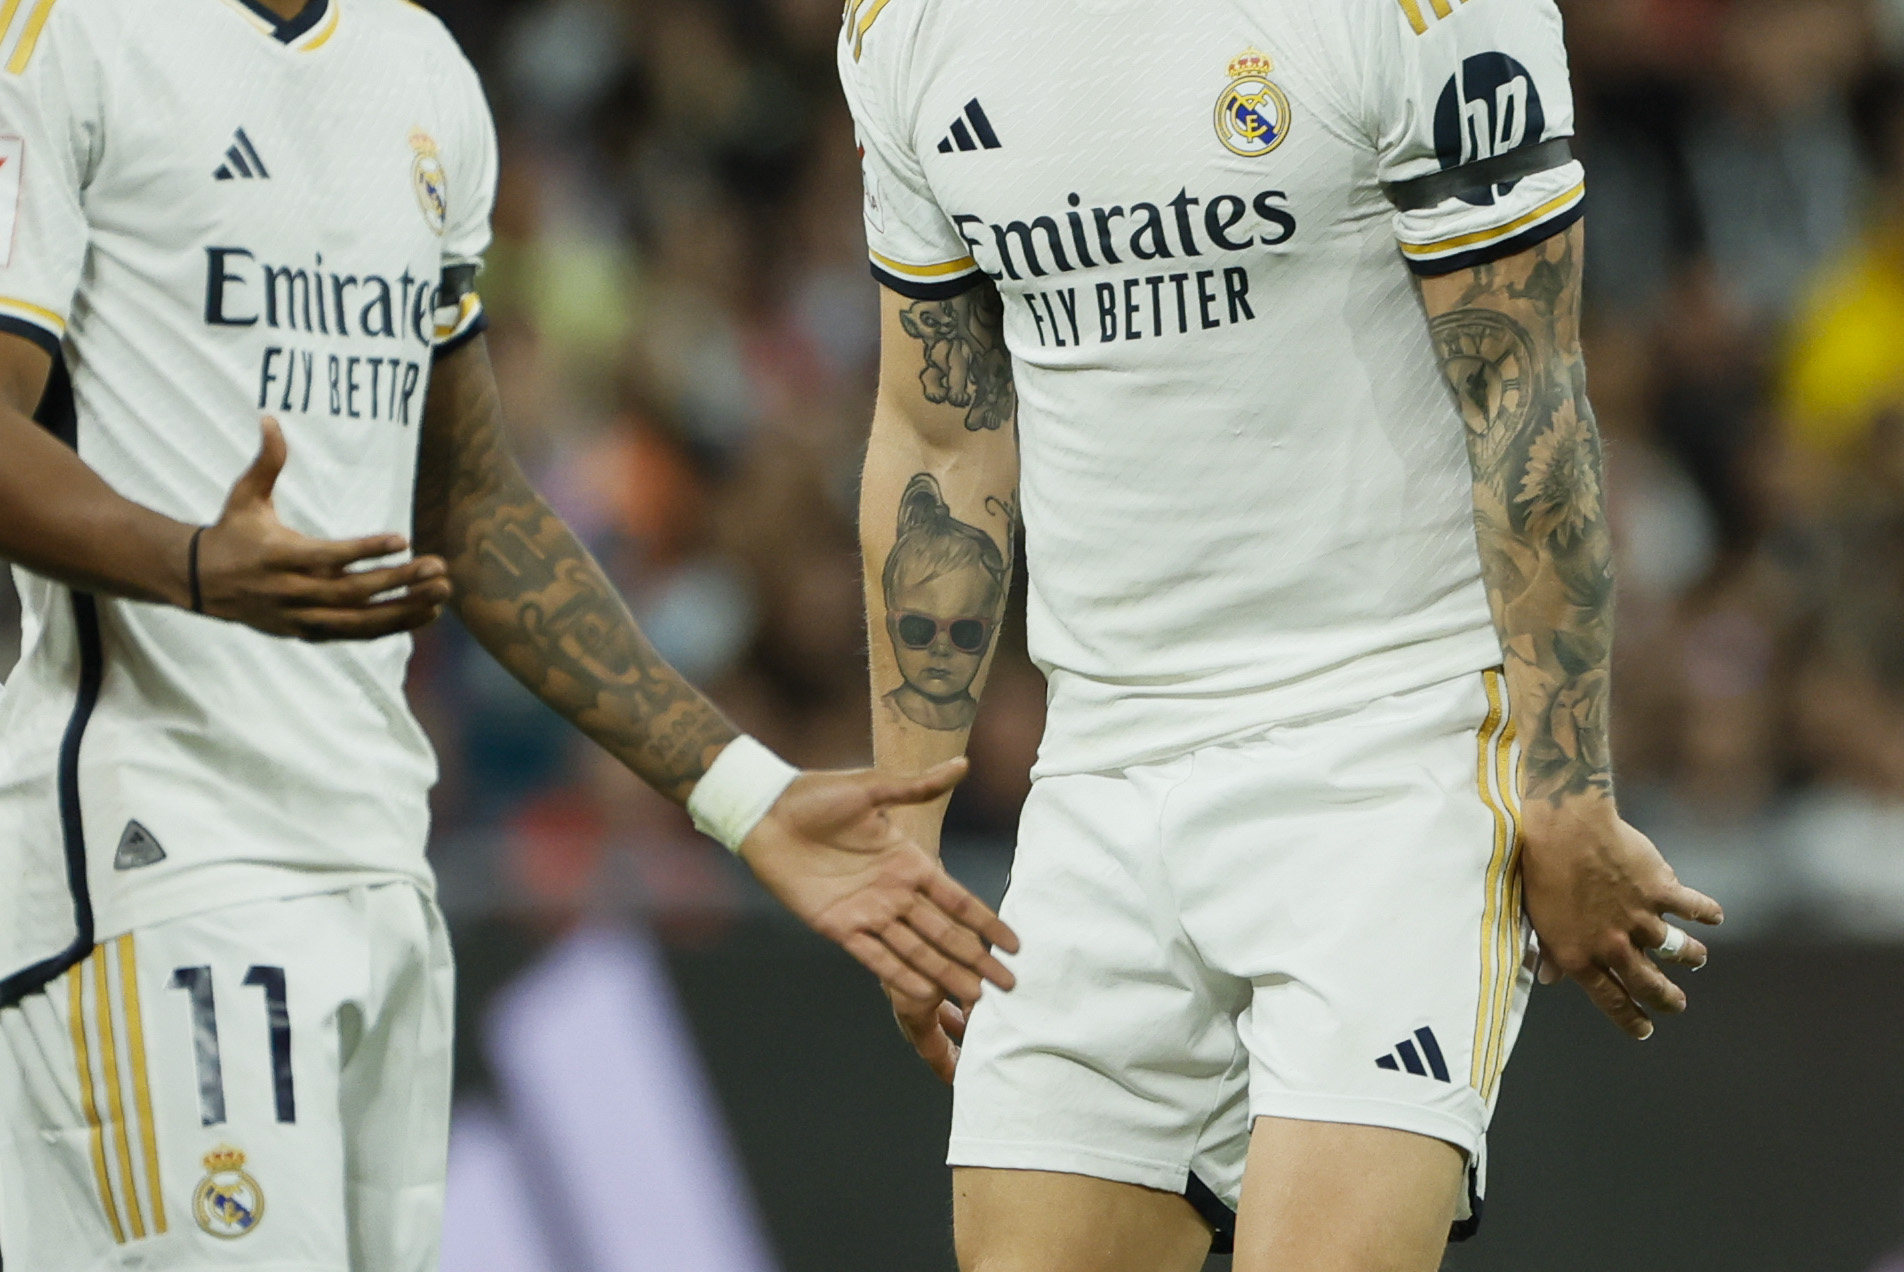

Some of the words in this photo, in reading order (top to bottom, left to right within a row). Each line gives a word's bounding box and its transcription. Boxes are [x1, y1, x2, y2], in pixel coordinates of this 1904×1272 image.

[952, 185, 1297, 281] Emirates
[1022, 287, 1081, 347] FLY
[1095, 266, 1256, 343] BETTER
[258, 346, 313, 414] FLY
[163, 964, 296, 1128] 11
